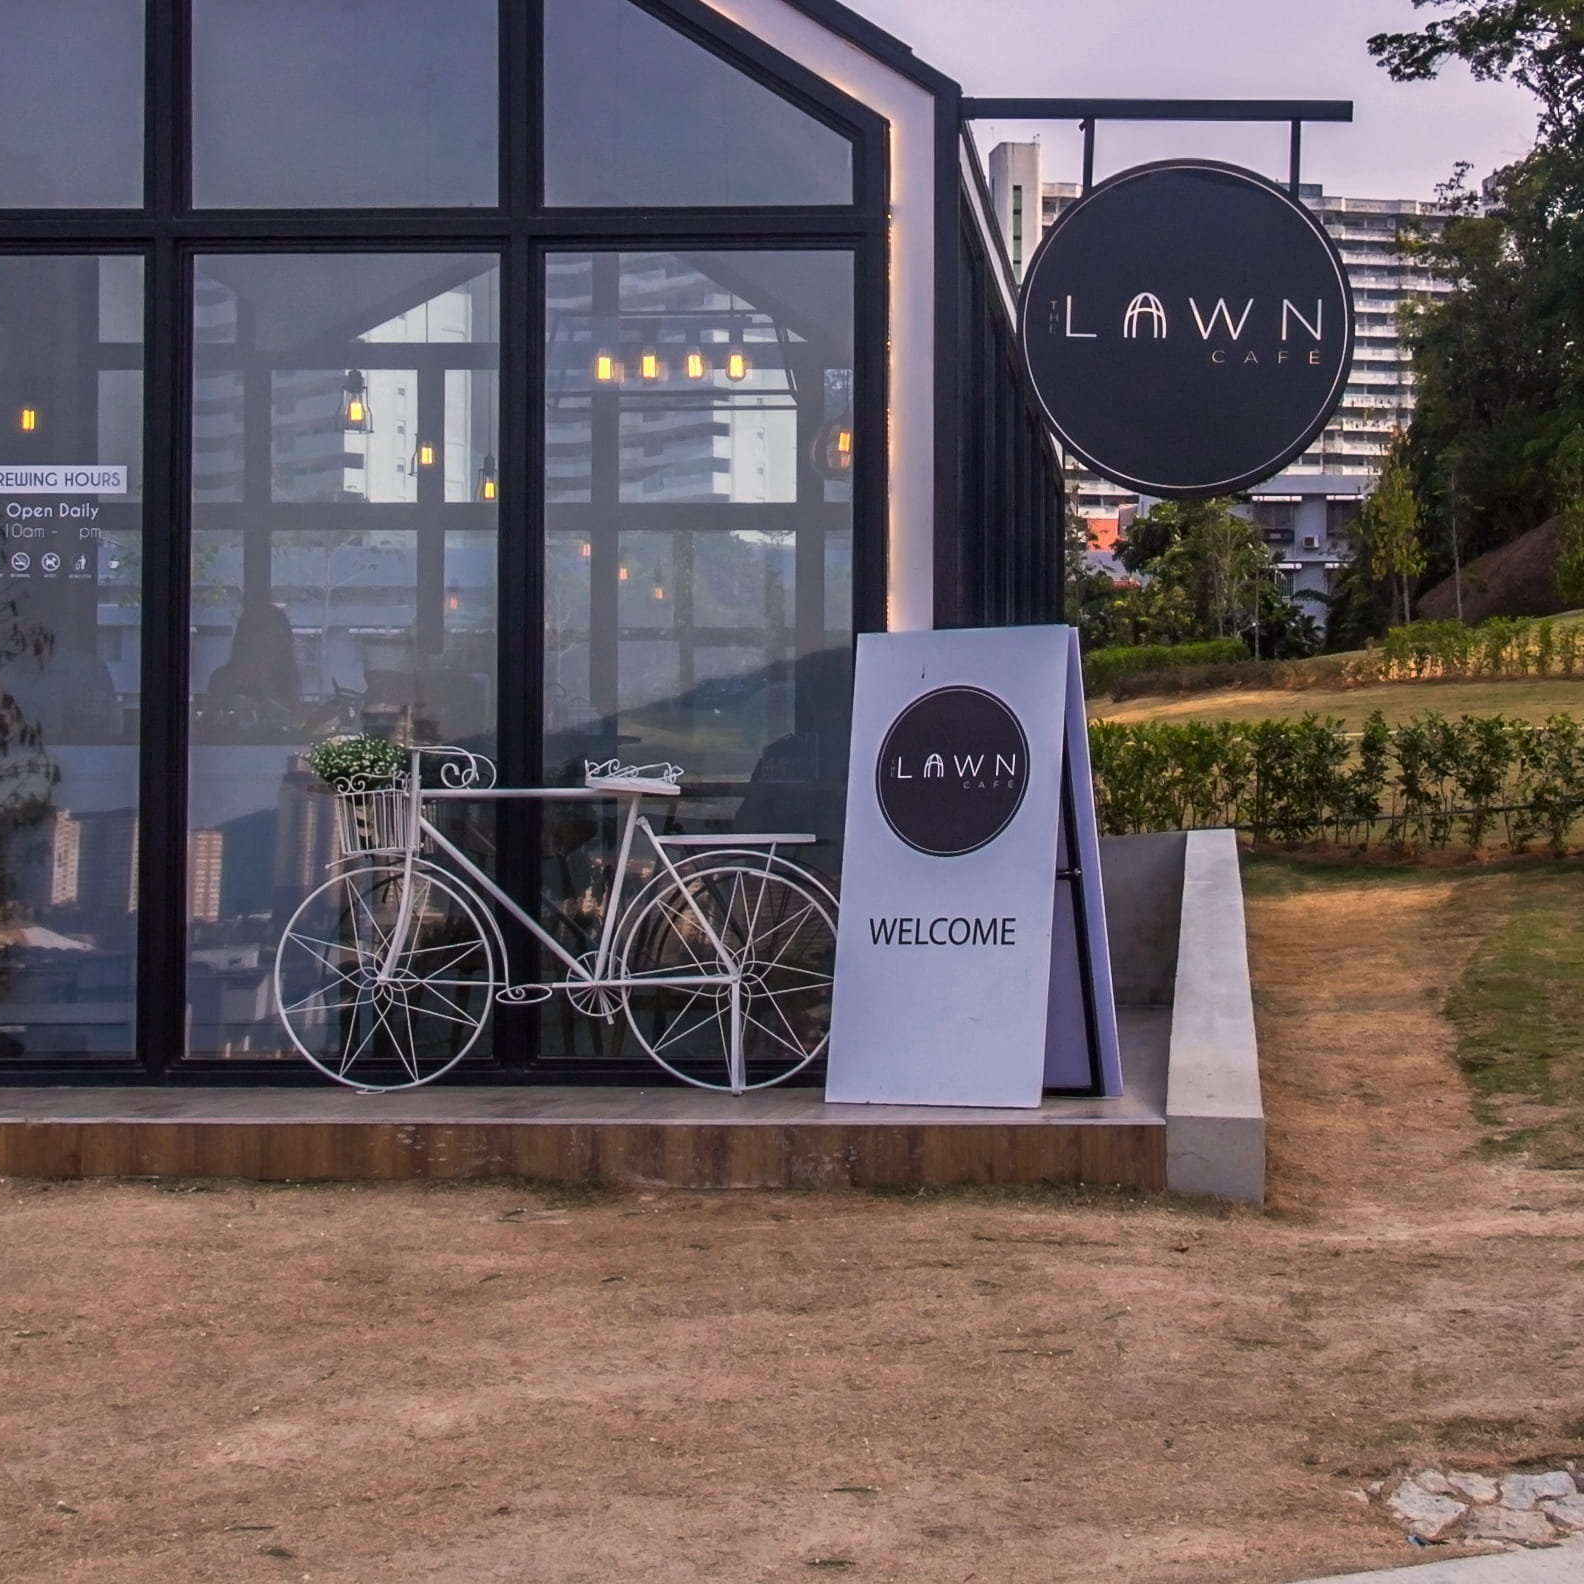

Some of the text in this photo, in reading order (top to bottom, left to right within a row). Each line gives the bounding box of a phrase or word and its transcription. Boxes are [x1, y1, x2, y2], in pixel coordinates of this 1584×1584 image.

[1066, 292, 1323, 342] LAWN
[64, 471, 121, 487] HOURS
[6, 502, 99, 520] Open Daily
[5, 522, 45, 539] 10am
[897, 753, 1016, 779] LAWN
[869, 917, 1017, 946] WELCOME
